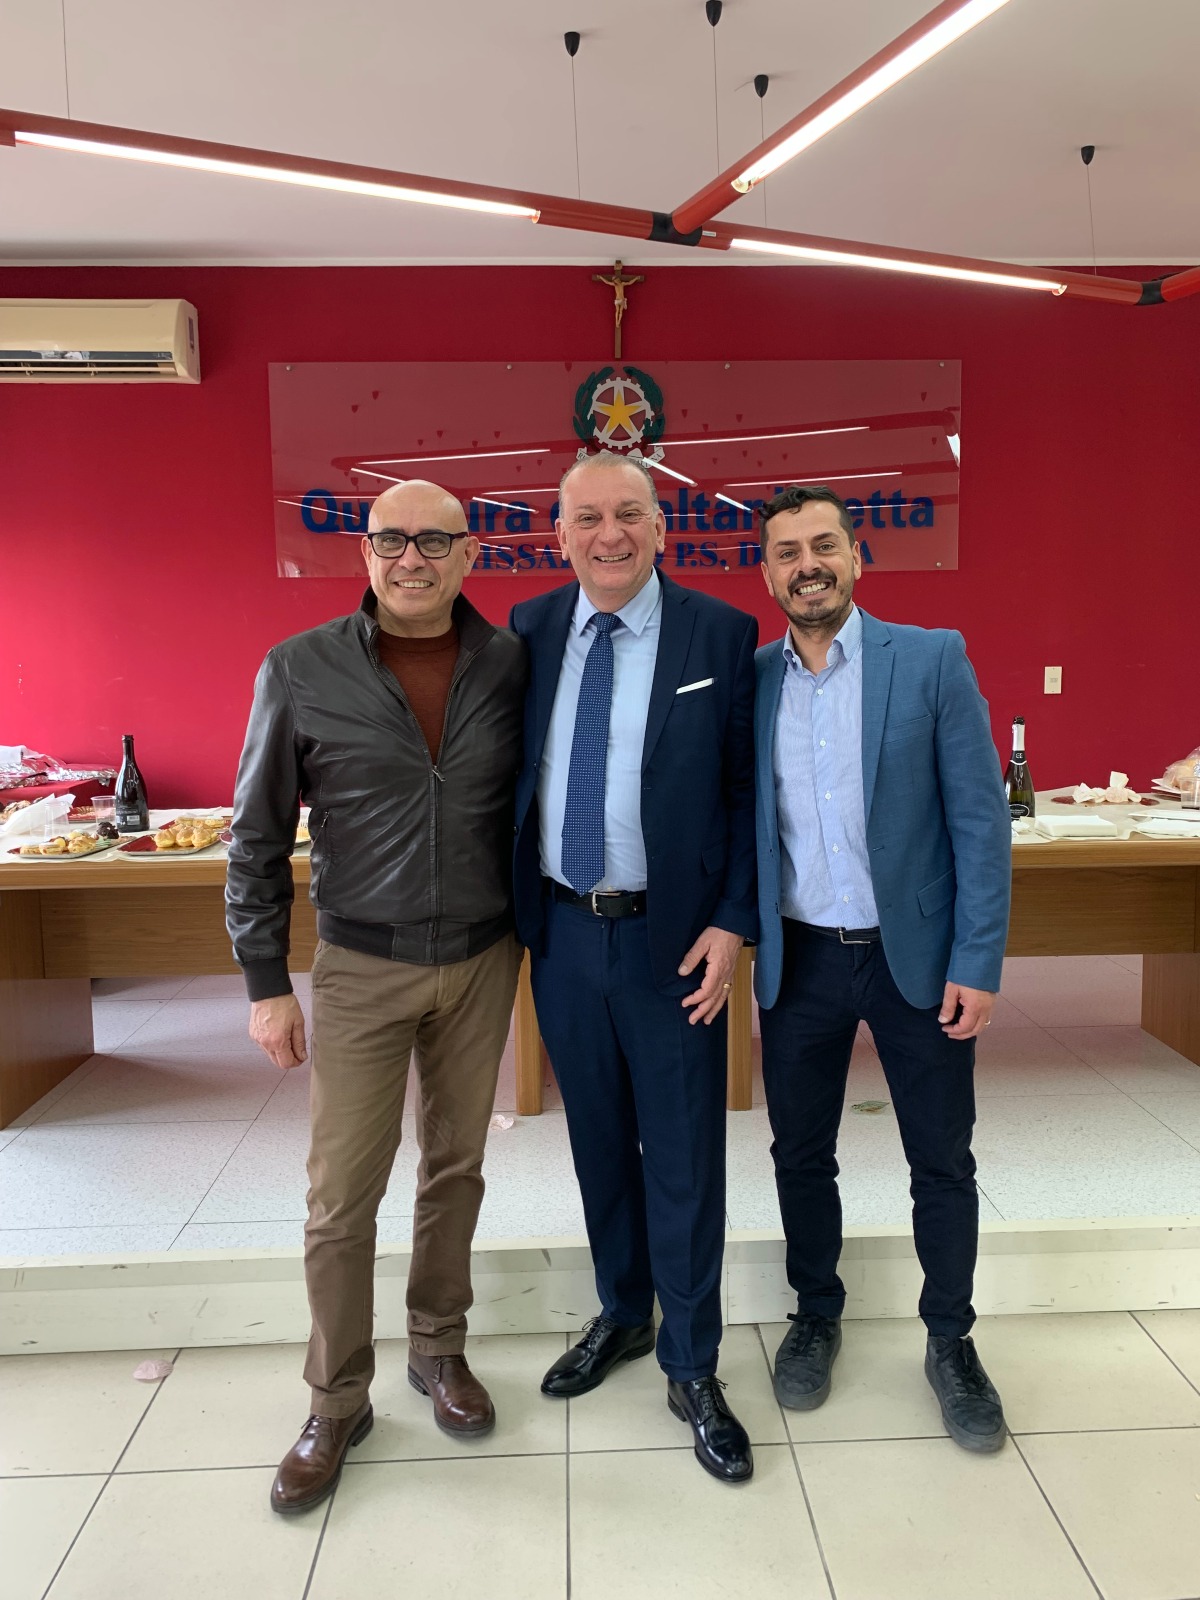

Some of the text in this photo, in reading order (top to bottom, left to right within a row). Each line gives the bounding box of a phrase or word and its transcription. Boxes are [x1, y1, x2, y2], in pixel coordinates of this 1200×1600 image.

[301, 488, 531, 533] Qura
[658, 487, 934, 531] ltanetta
[675, 541, 727, 567] P.S.
